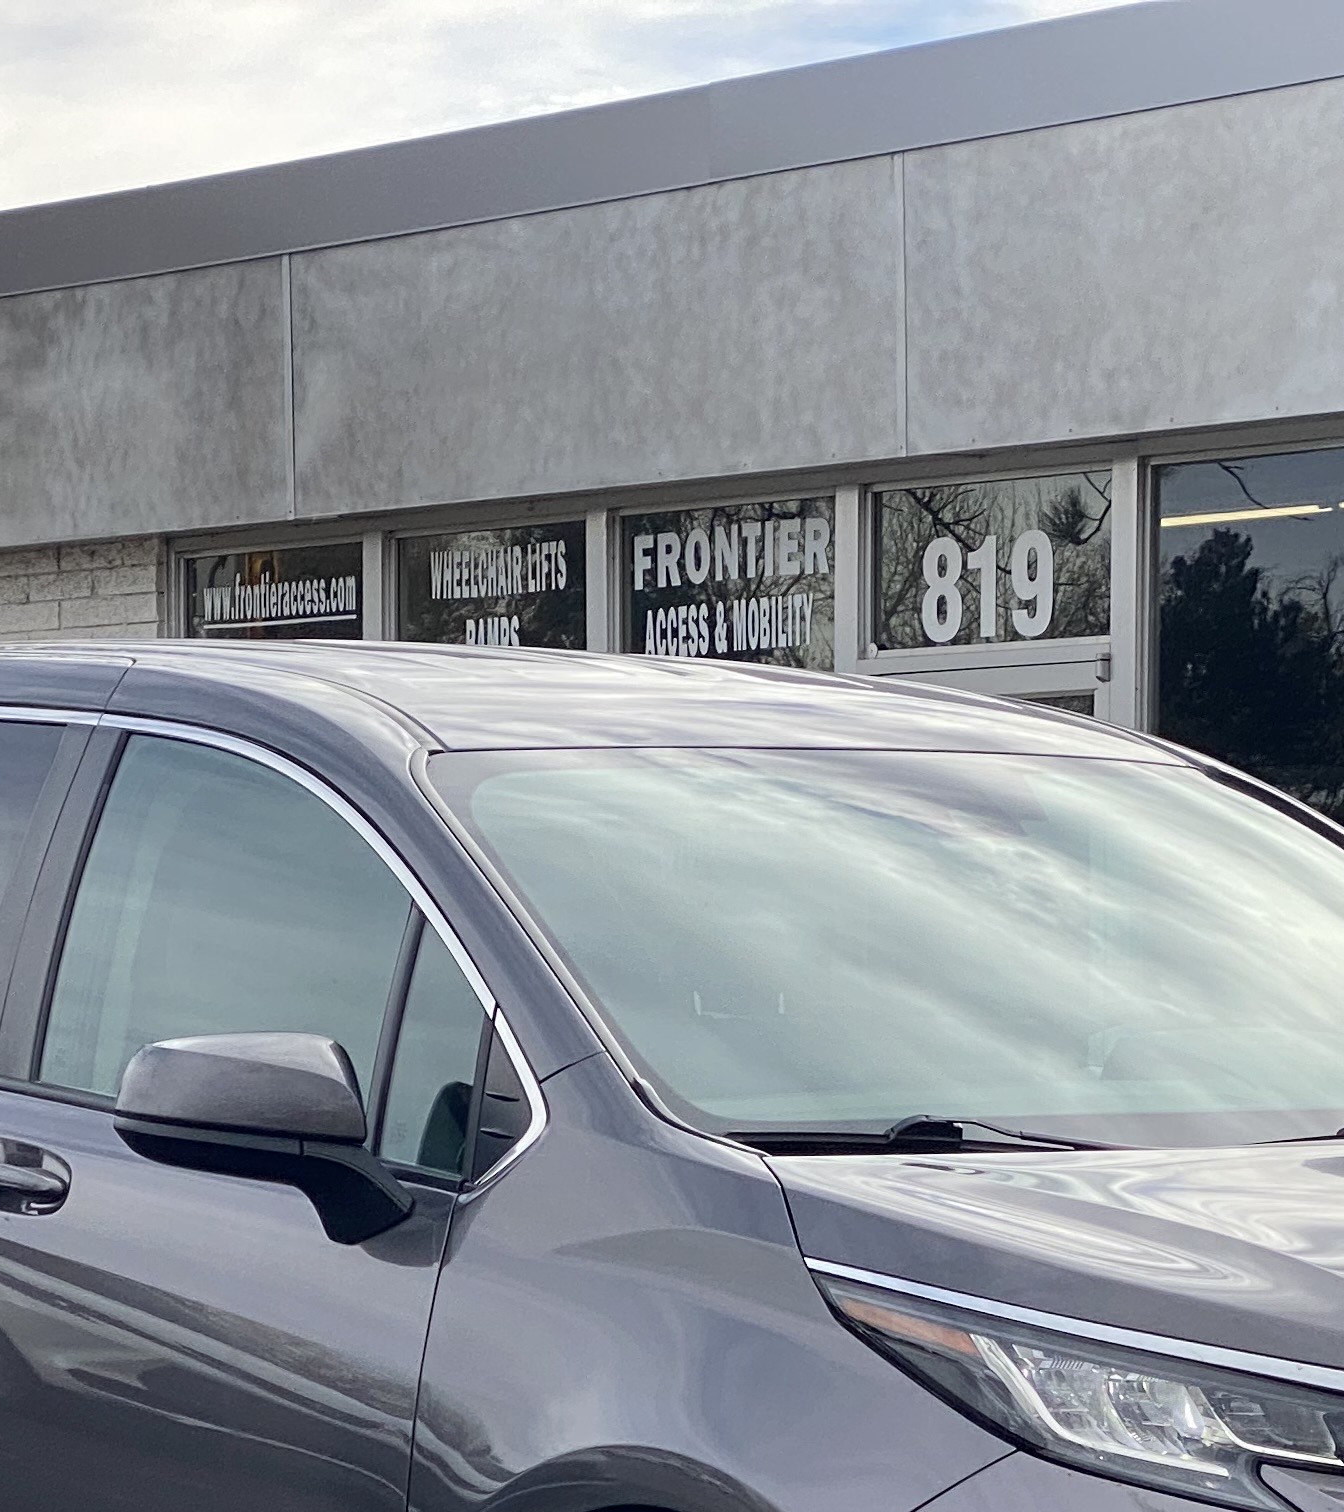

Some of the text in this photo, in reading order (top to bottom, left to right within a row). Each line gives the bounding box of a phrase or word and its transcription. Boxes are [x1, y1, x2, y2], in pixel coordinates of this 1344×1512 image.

[430, 541, 567, 600] WHEELCHAIR LIFTS
[633, 517, 831, 590] FRONTIER
[203, 572, 356, 621] www.frontieraccess.com
[921, 530, 1054, 643] 819
[644, 593, 813, 656] ACCESS & MOBILITY
